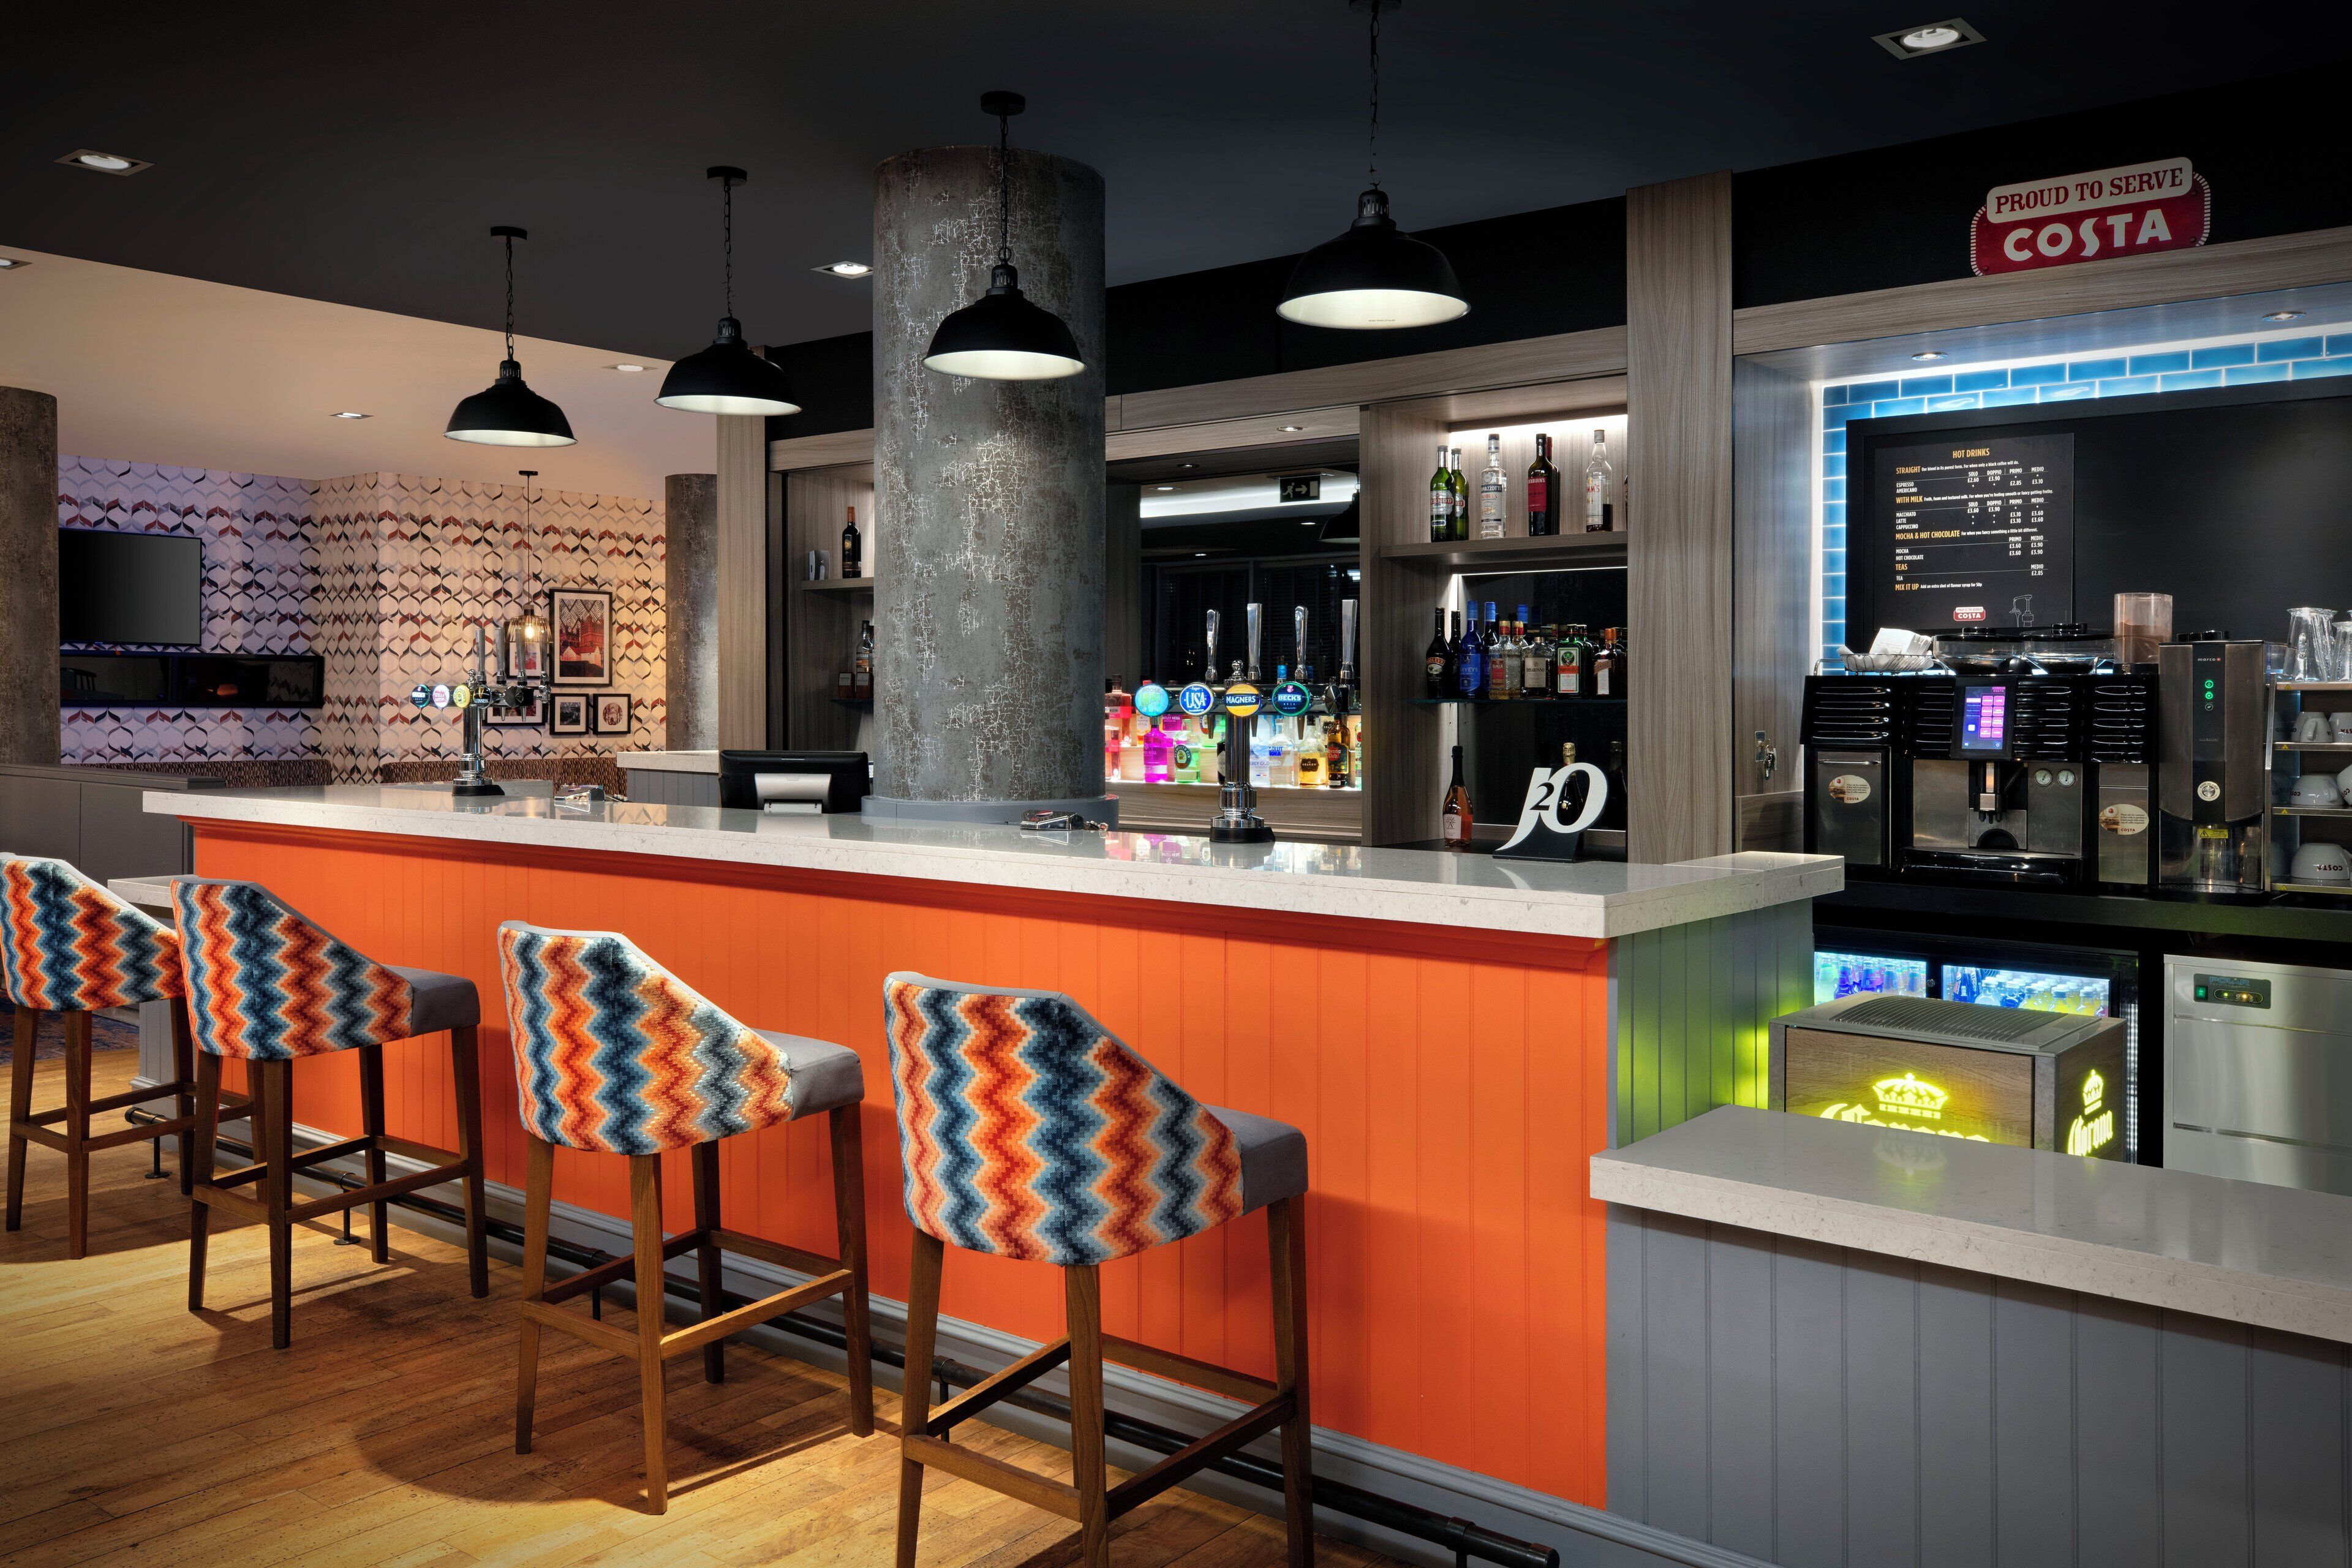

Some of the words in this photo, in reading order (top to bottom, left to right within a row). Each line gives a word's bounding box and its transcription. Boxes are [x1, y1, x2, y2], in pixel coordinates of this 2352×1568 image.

[1996, 186, 2069, 214] PROUD
[2076, 181, 2103, 201] TO
[2109, 167, 2183, 197] SERVE
[2003, 209, 2172, 262] COSTA
[1966, 448, 1990, 458] DRINKS
[1586, 483, 1600, 493] MM'S
[1931, 530, 1960, 538] CHOCOLATE
[1186, 692, 1205, 709] LISA
[2209, 976, 2250, 986] POLAR
[2067, 1109, 2113, 1156] Corona
